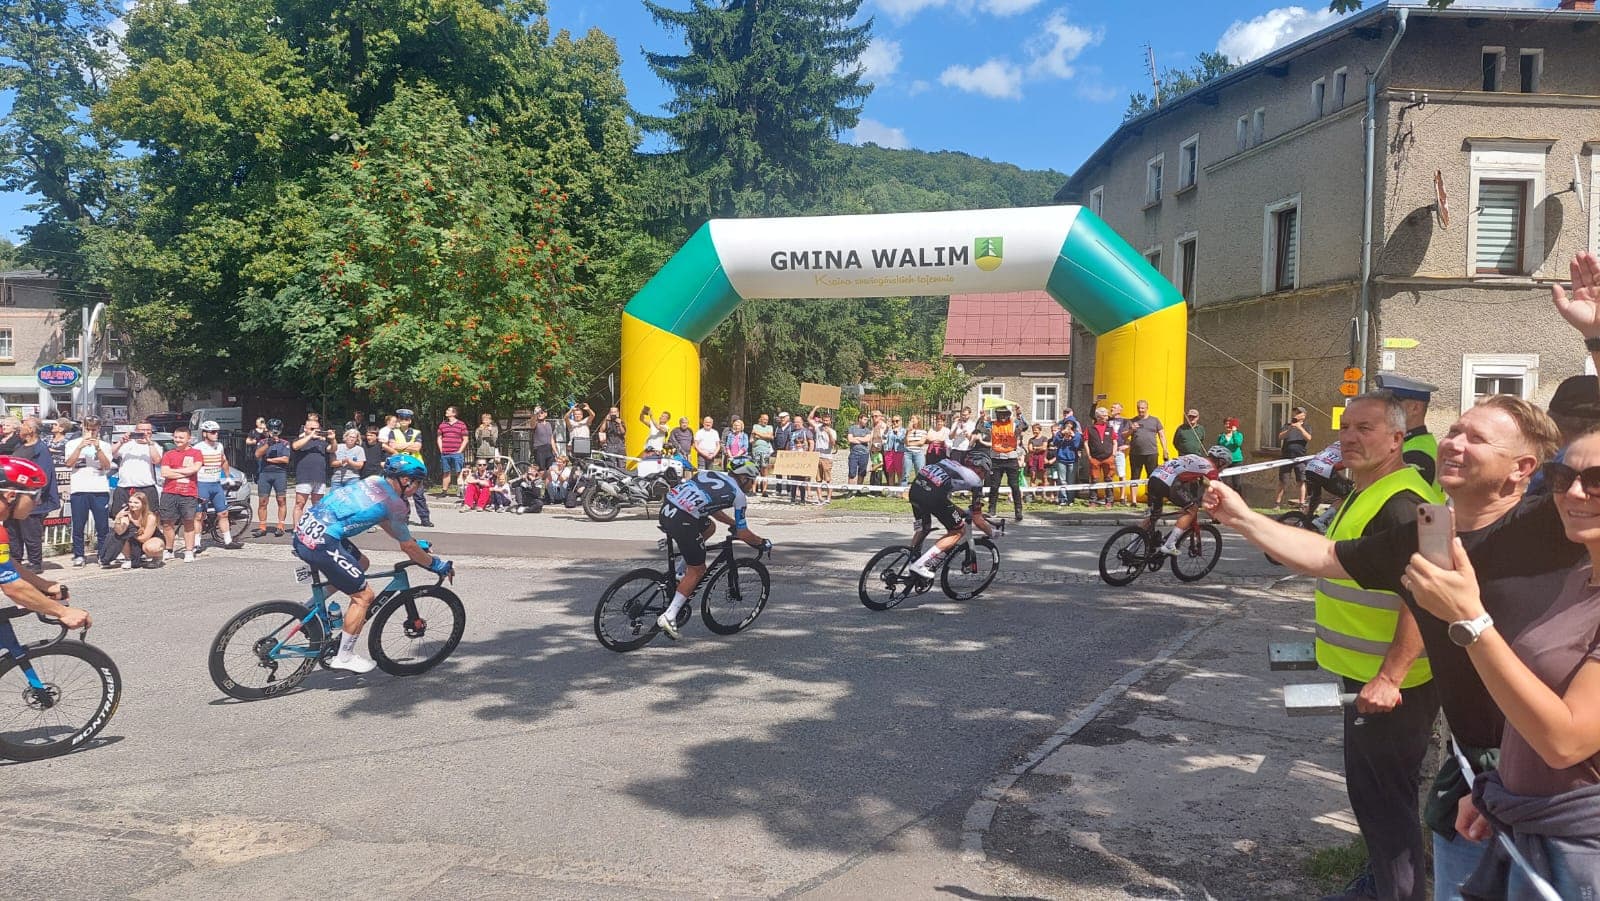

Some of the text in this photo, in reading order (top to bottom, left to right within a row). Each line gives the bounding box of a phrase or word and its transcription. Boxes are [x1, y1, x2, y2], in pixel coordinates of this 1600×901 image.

[770, 245, 969, 271] GMINA WALIM
[814, 273, 850, 286] Kraina
[686, 490, 704, 507] 114
[72, 667, 115, 745] BONTRAGER
